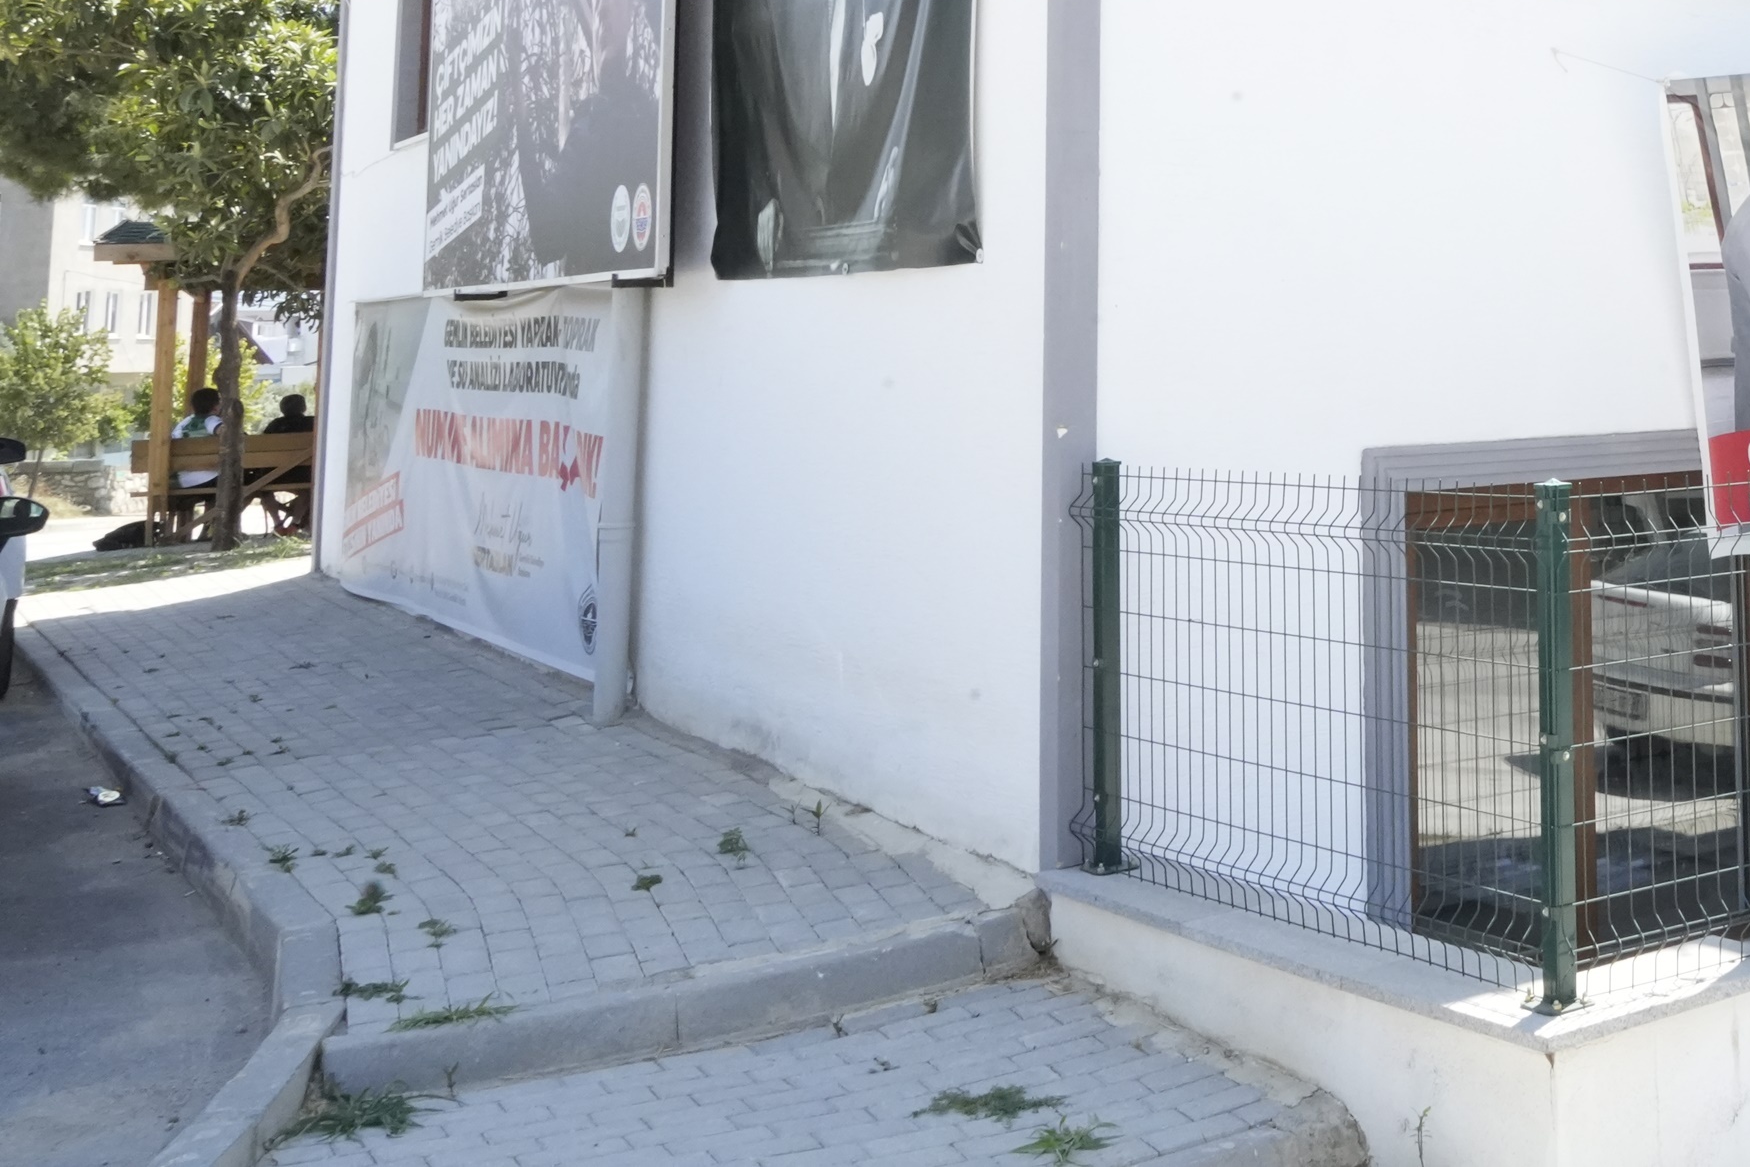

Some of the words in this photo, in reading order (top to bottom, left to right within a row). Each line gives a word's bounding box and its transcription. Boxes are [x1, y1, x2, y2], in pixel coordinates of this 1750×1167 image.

[433, 90, 498, 184] YANINDAYIZ!
[434, 95, 454, 142] HER
[456, 49, 498, 120] ZAMAN
